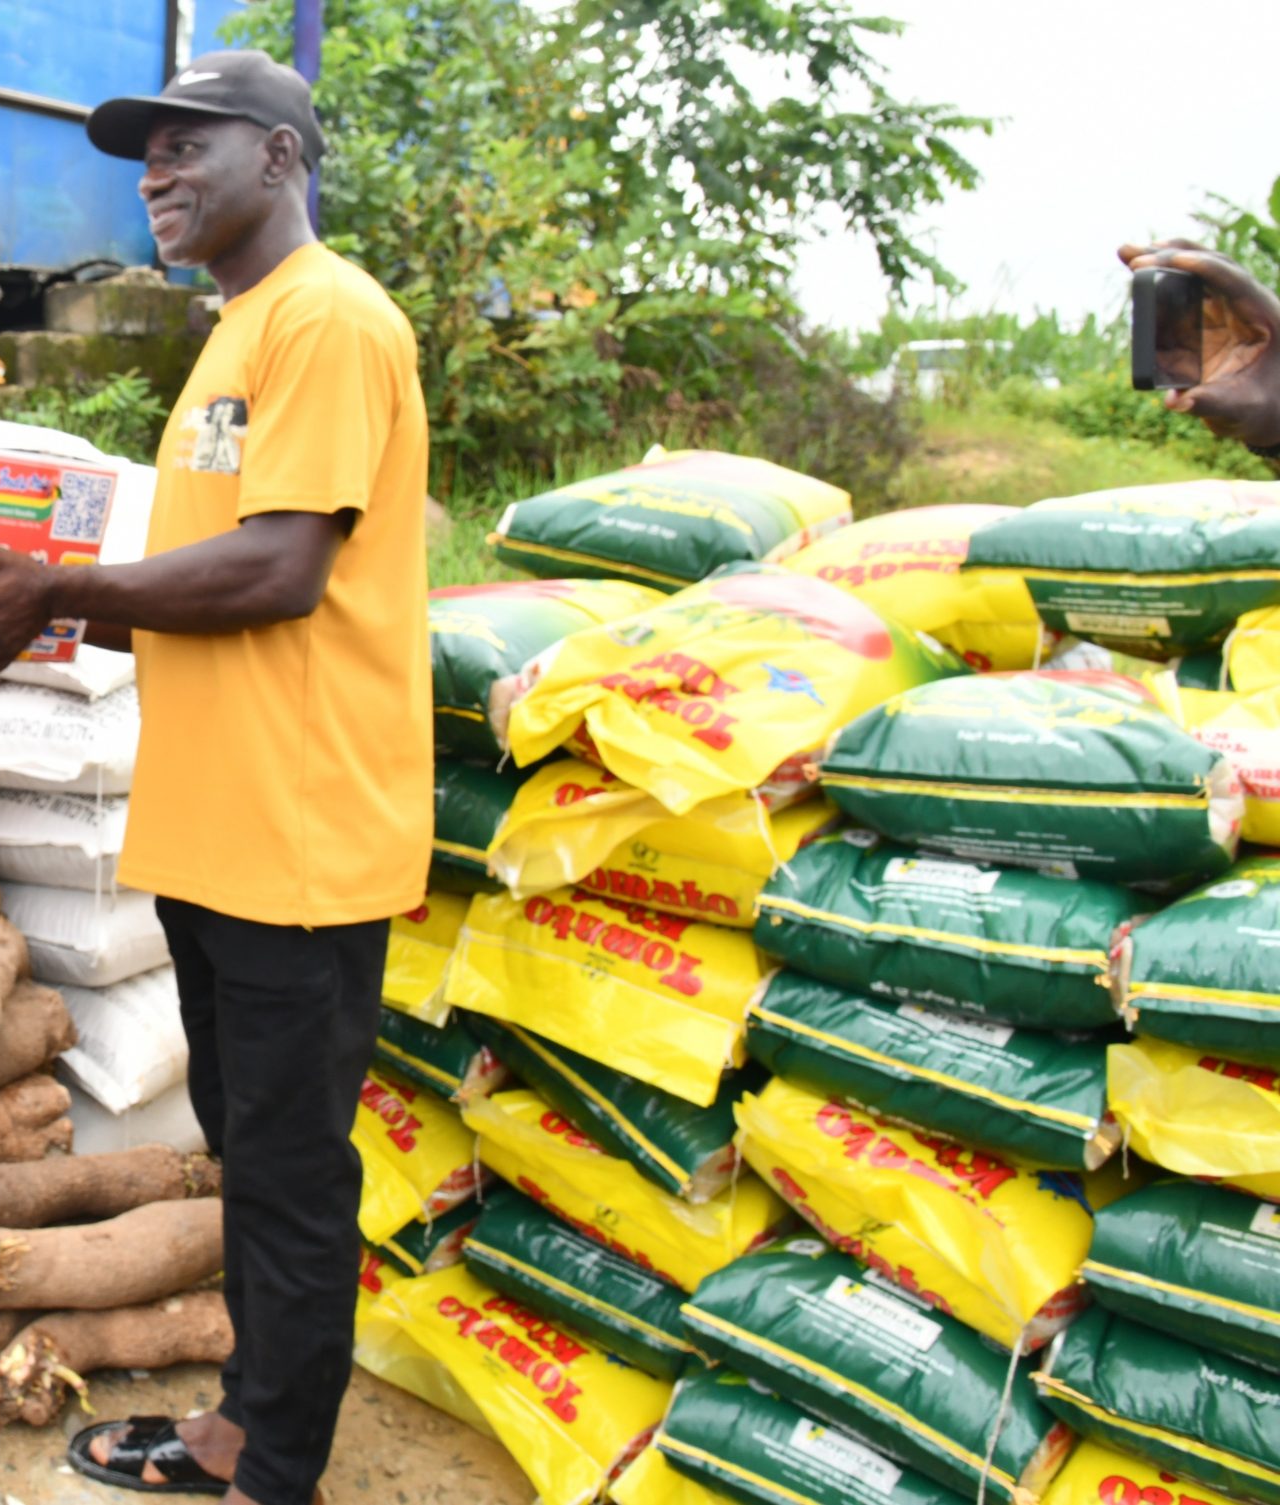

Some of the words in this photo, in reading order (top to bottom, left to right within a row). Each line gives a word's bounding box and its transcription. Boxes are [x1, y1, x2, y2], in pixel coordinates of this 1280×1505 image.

[582, 867, 739, 918] omato
[525, 896, 703, 997] Tomato
[438, 1296, 584, 1424] Tomato
